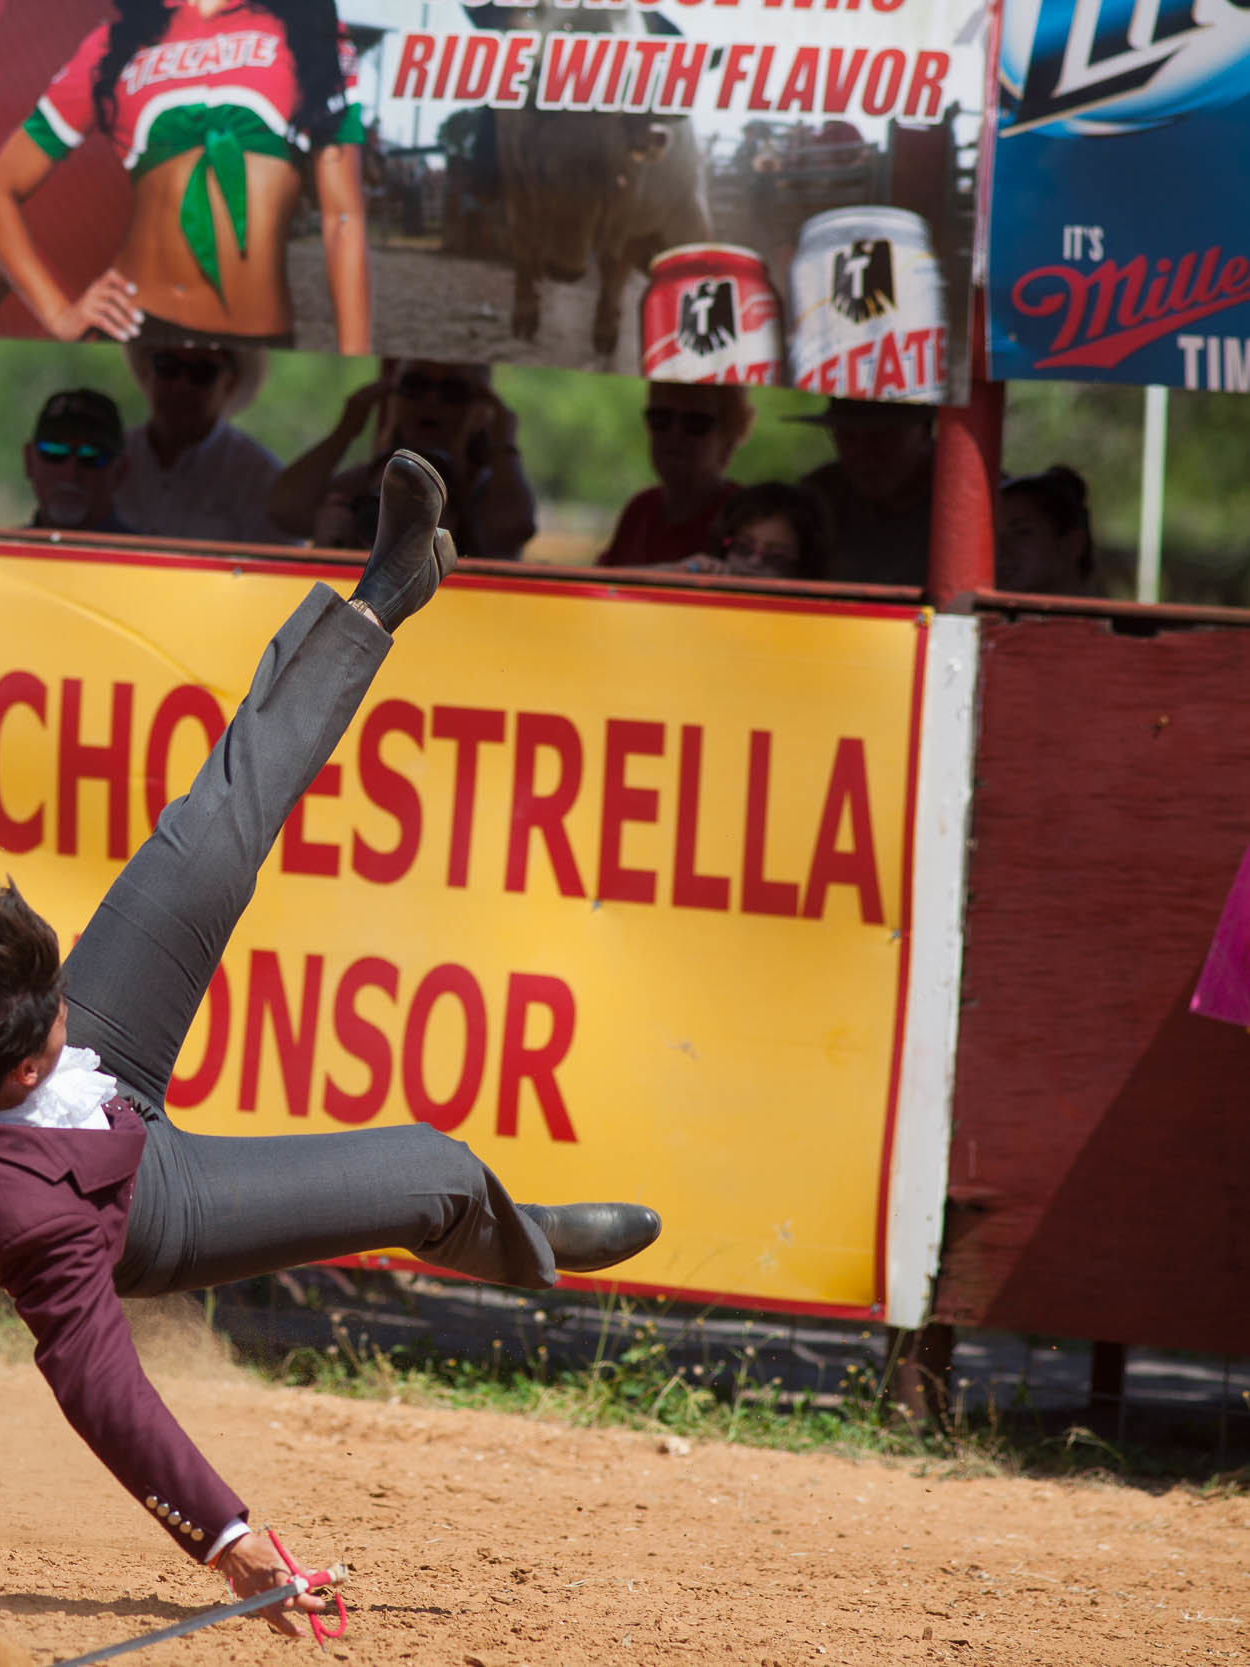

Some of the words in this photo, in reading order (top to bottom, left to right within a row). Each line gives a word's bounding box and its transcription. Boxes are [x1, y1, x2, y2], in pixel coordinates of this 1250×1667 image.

[121, 30, 280, 95] TECATE
[392, 33, 533, 104] RIDE
[544, 37, 710, 109] WITH
[716, 42, 951, 118] FLAVOR
[1062, 224, 1105, 262] IT'S
[163, 948, 579, 1144] ONSOR
